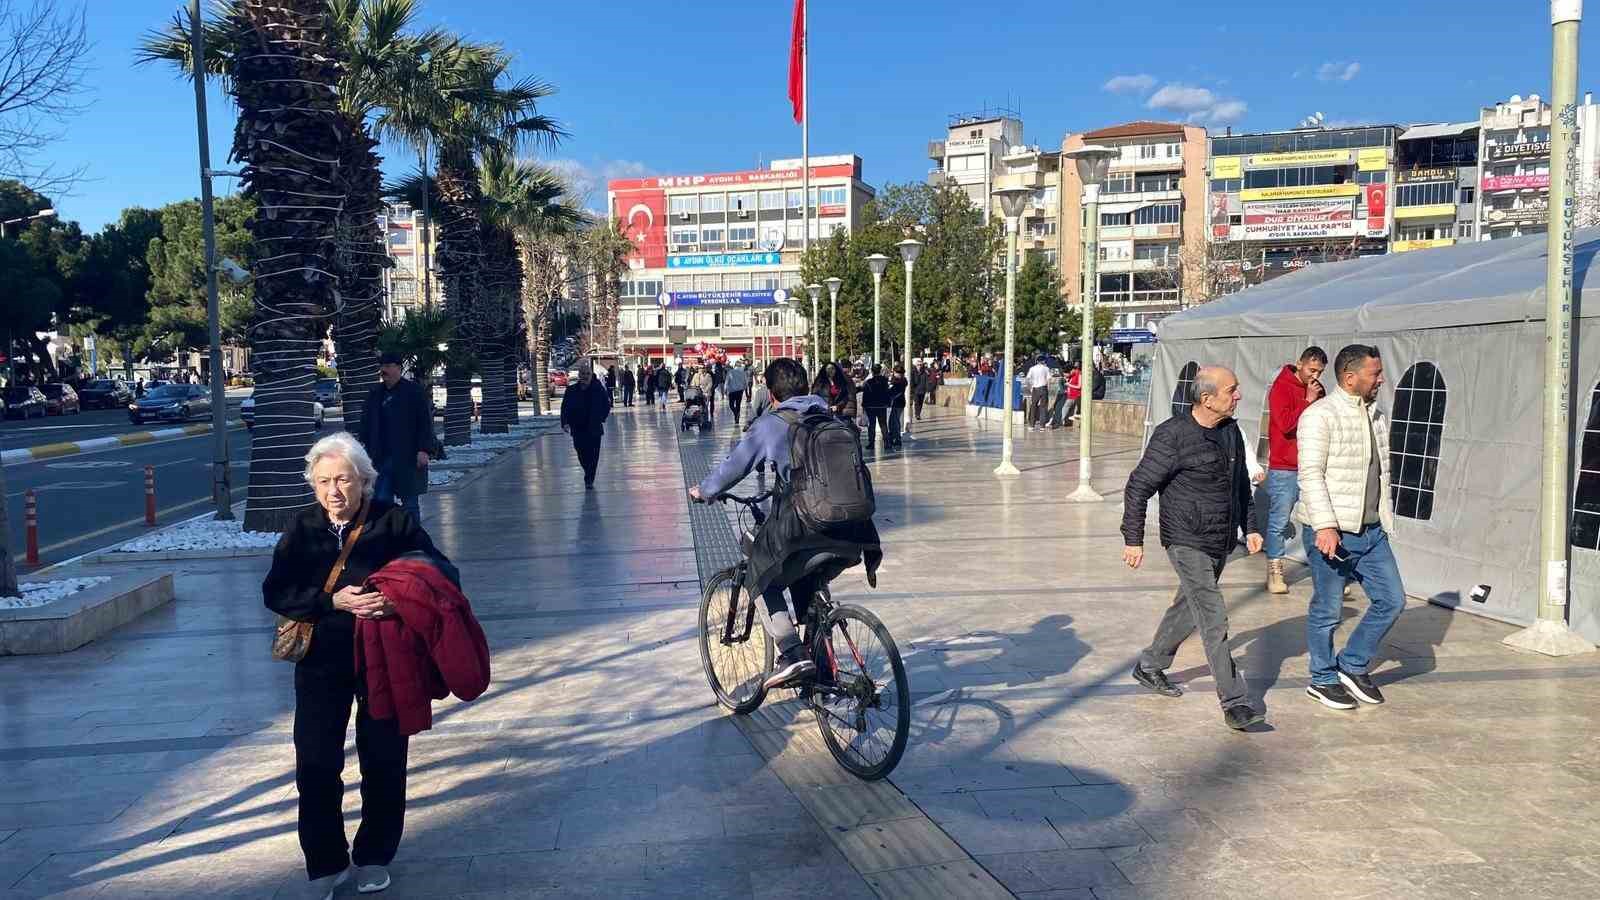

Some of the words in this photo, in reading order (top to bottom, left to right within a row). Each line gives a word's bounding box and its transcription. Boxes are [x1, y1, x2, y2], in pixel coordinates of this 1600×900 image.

[1504, 141, 1551, 153] DİYETİSYE
[658, 176, 705, 188] MHP
[709, 175, 734, 185] AYDIN
[748, 170, 798, 182] BAŞKANLIĞI
[1264, 214, 1284, 224] DUR
[1245, 223, 1296, 233] CUMHURİYET
[1297, 222, 1319, 231] HALK
[1320, 220, 1352, 230] PARTİSİ
[1293, 229, 1328, 237] BAŞKANLIĞI
[684, 255, 704, 265] AYDIN
[706, 253, 724, 264] ÜLKÜ
[726, 251, 763, 263] OCAKLARI
[698, 290, 741, 299] BÜYÜKŞEHİR
